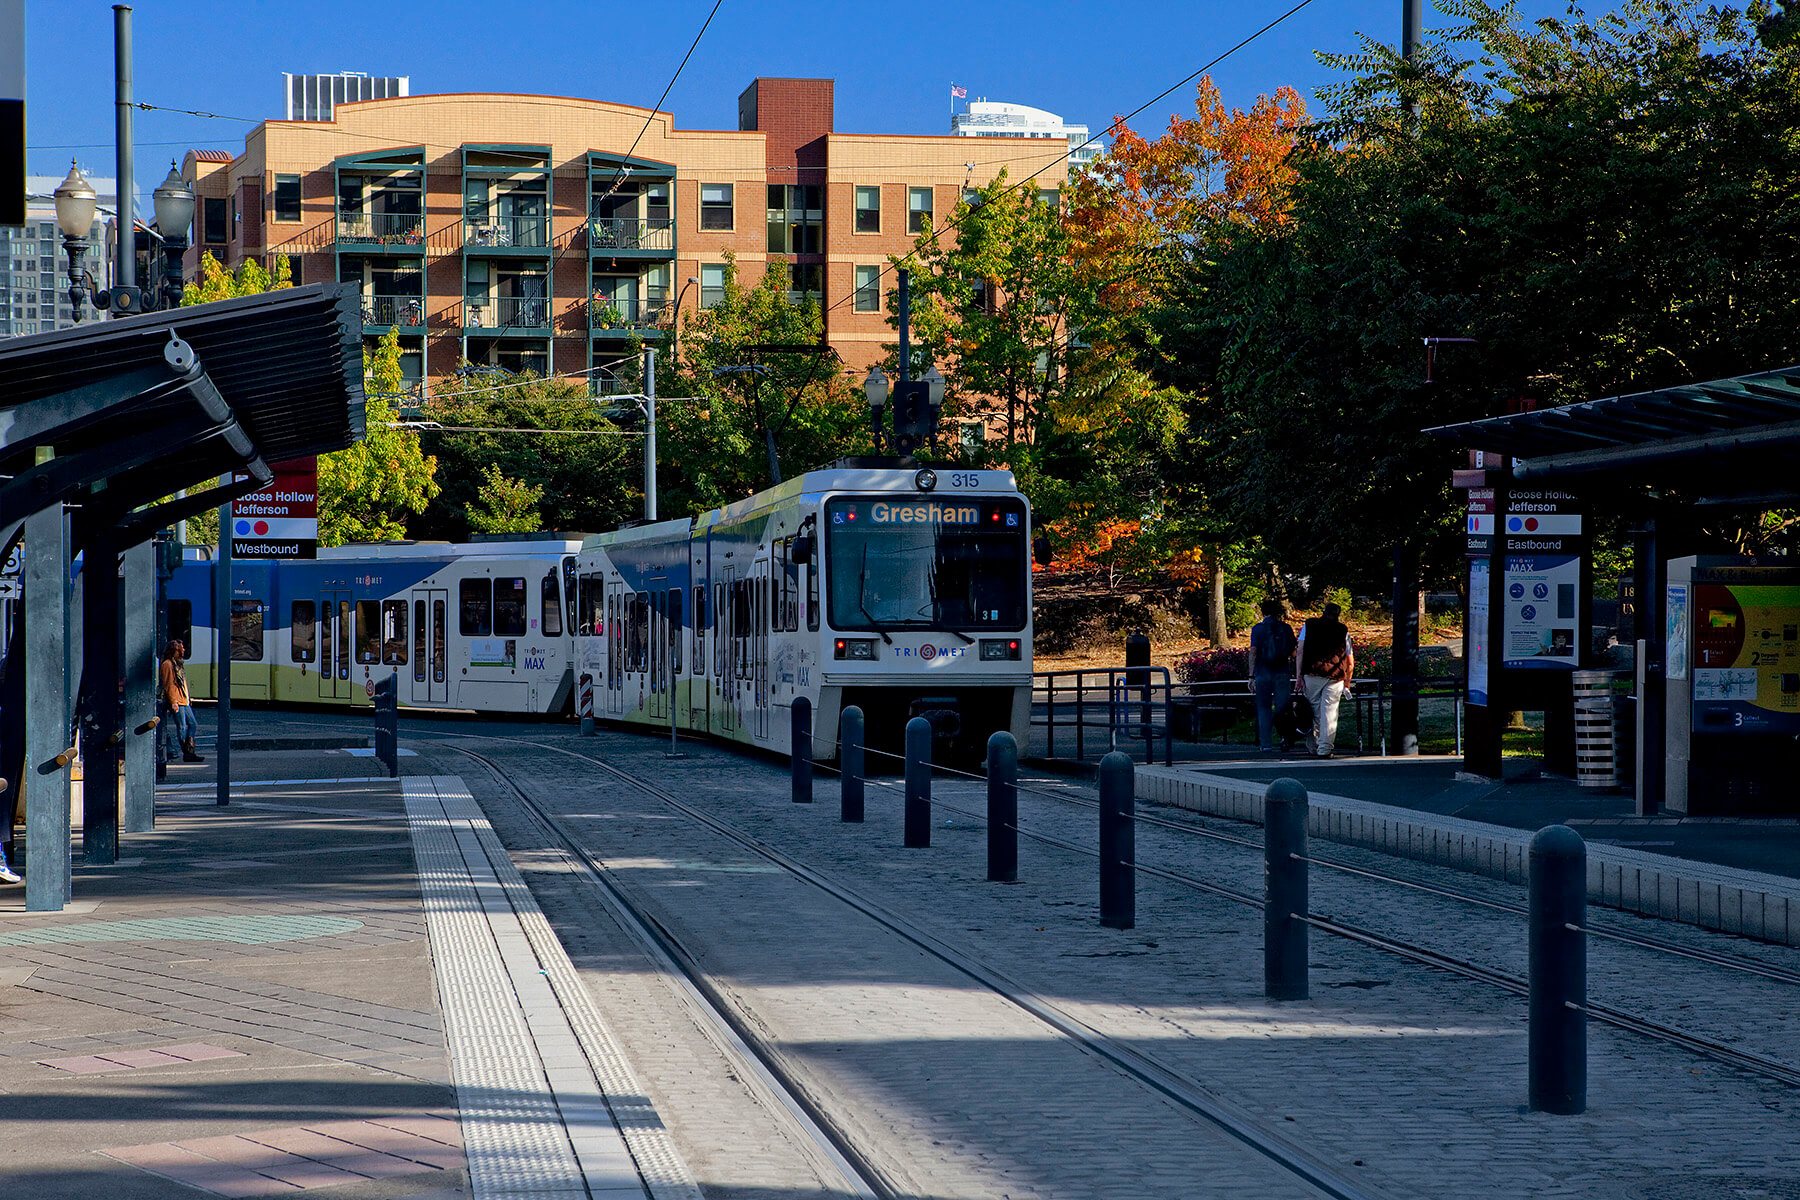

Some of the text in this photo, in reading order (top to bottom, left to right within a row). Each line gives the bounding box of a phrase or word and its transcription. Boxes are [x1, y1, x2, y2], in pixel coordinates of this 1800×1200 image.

[951, 474, 979, 488] 315
[275, 491, 314, 502] Hollow
[1508, 489, 1542, 500] Goose
[235, 504, 289, 515] Jefferson
[1508, 501, 1557, 512] Jefferson
[871, 502, 978, 524] Gresham
[235, 543, 299, 554] Westbound
[1507, 539, 1562, 550] Eastbound
[1509, 563, 1534, 573] MAX
[1703, 648, 1710, 664] 1
[1751, 651, 1760, 666] 2
[524, 657, 545, 670] MAX
[1734, 712, 1743, 727] 3
